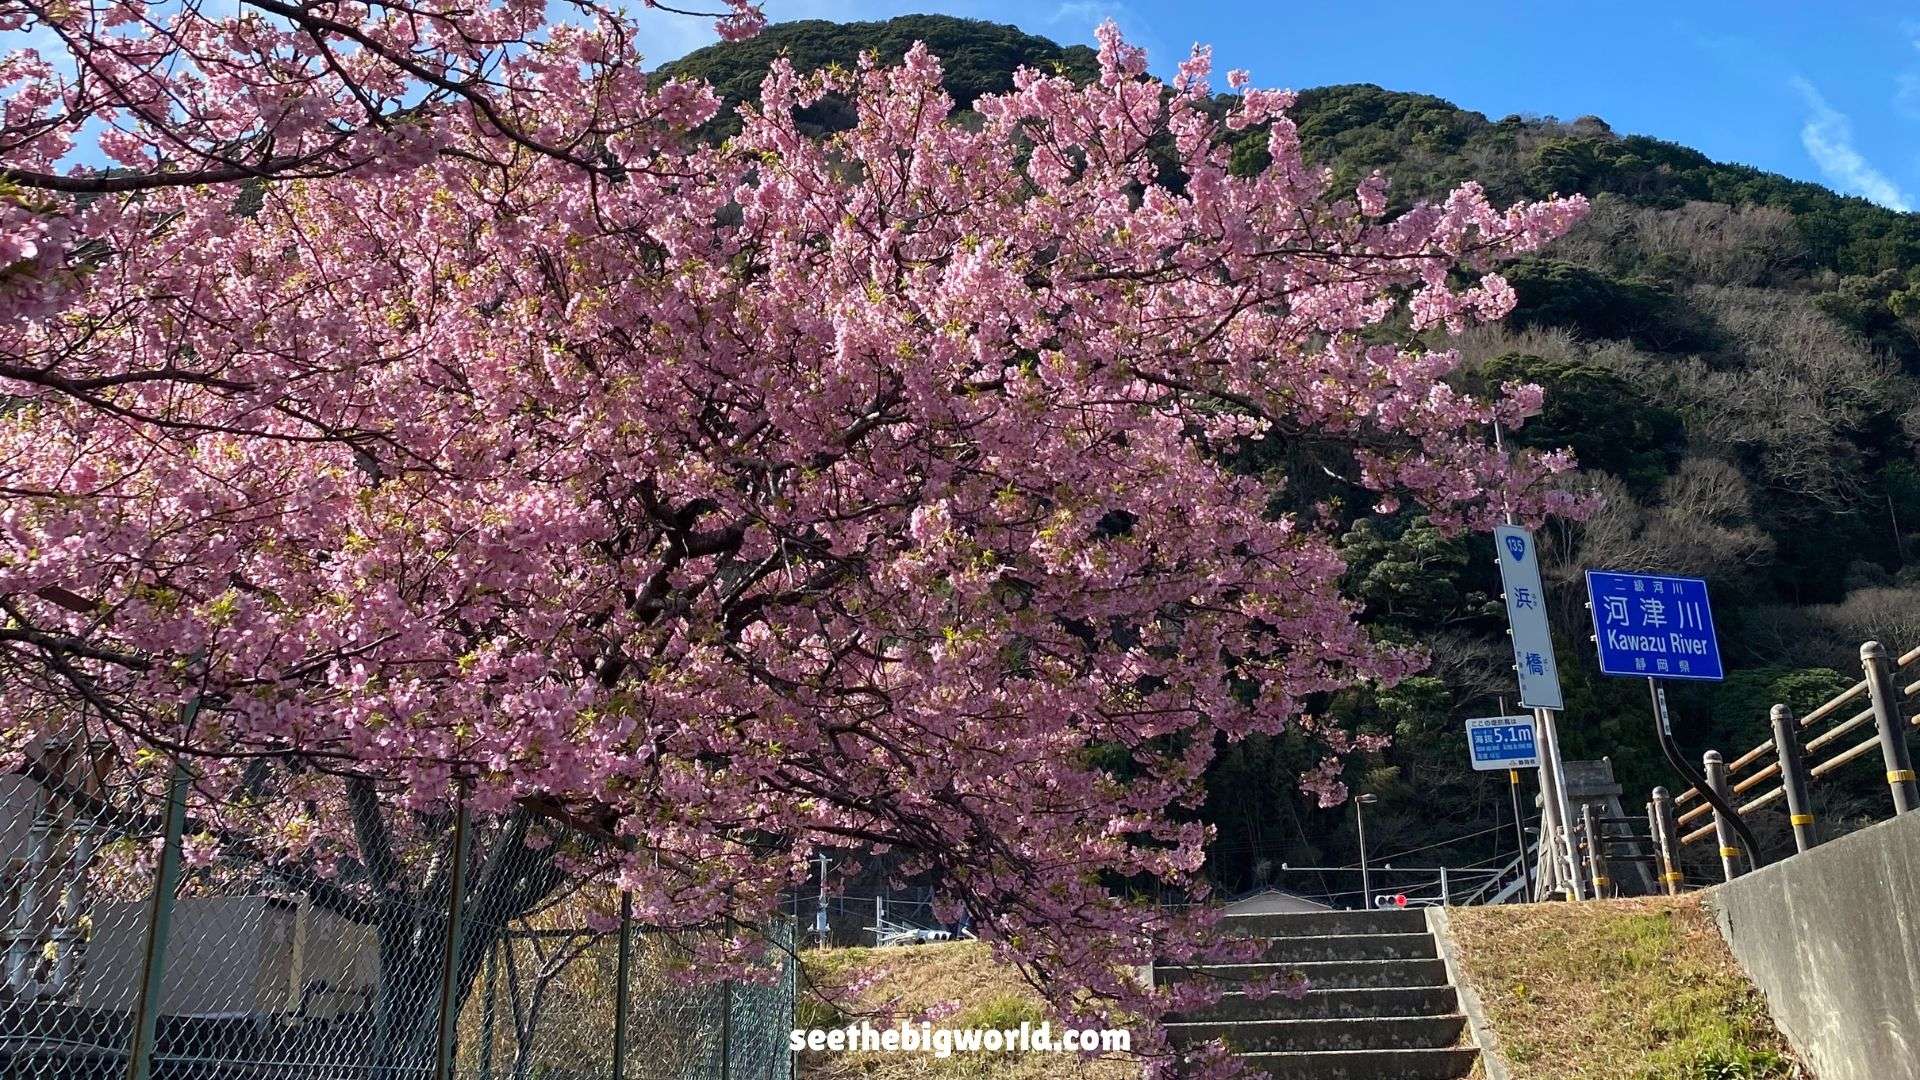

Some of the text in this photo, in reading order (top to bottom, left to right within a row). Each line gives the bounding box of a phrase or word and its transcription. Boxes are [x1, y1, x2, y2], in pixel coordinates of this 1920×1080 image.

[1507, 539, 1523, 552] 135
[1614, 579, 1684, 594] 二級河川
[1603, 595, 1703, 631] 河津川
[1607, 629, 1707, 655] Kawazu River
[1635, 657, 1690, 673] 静岡県
[1493, 727, 1532, 743] 5.1m
